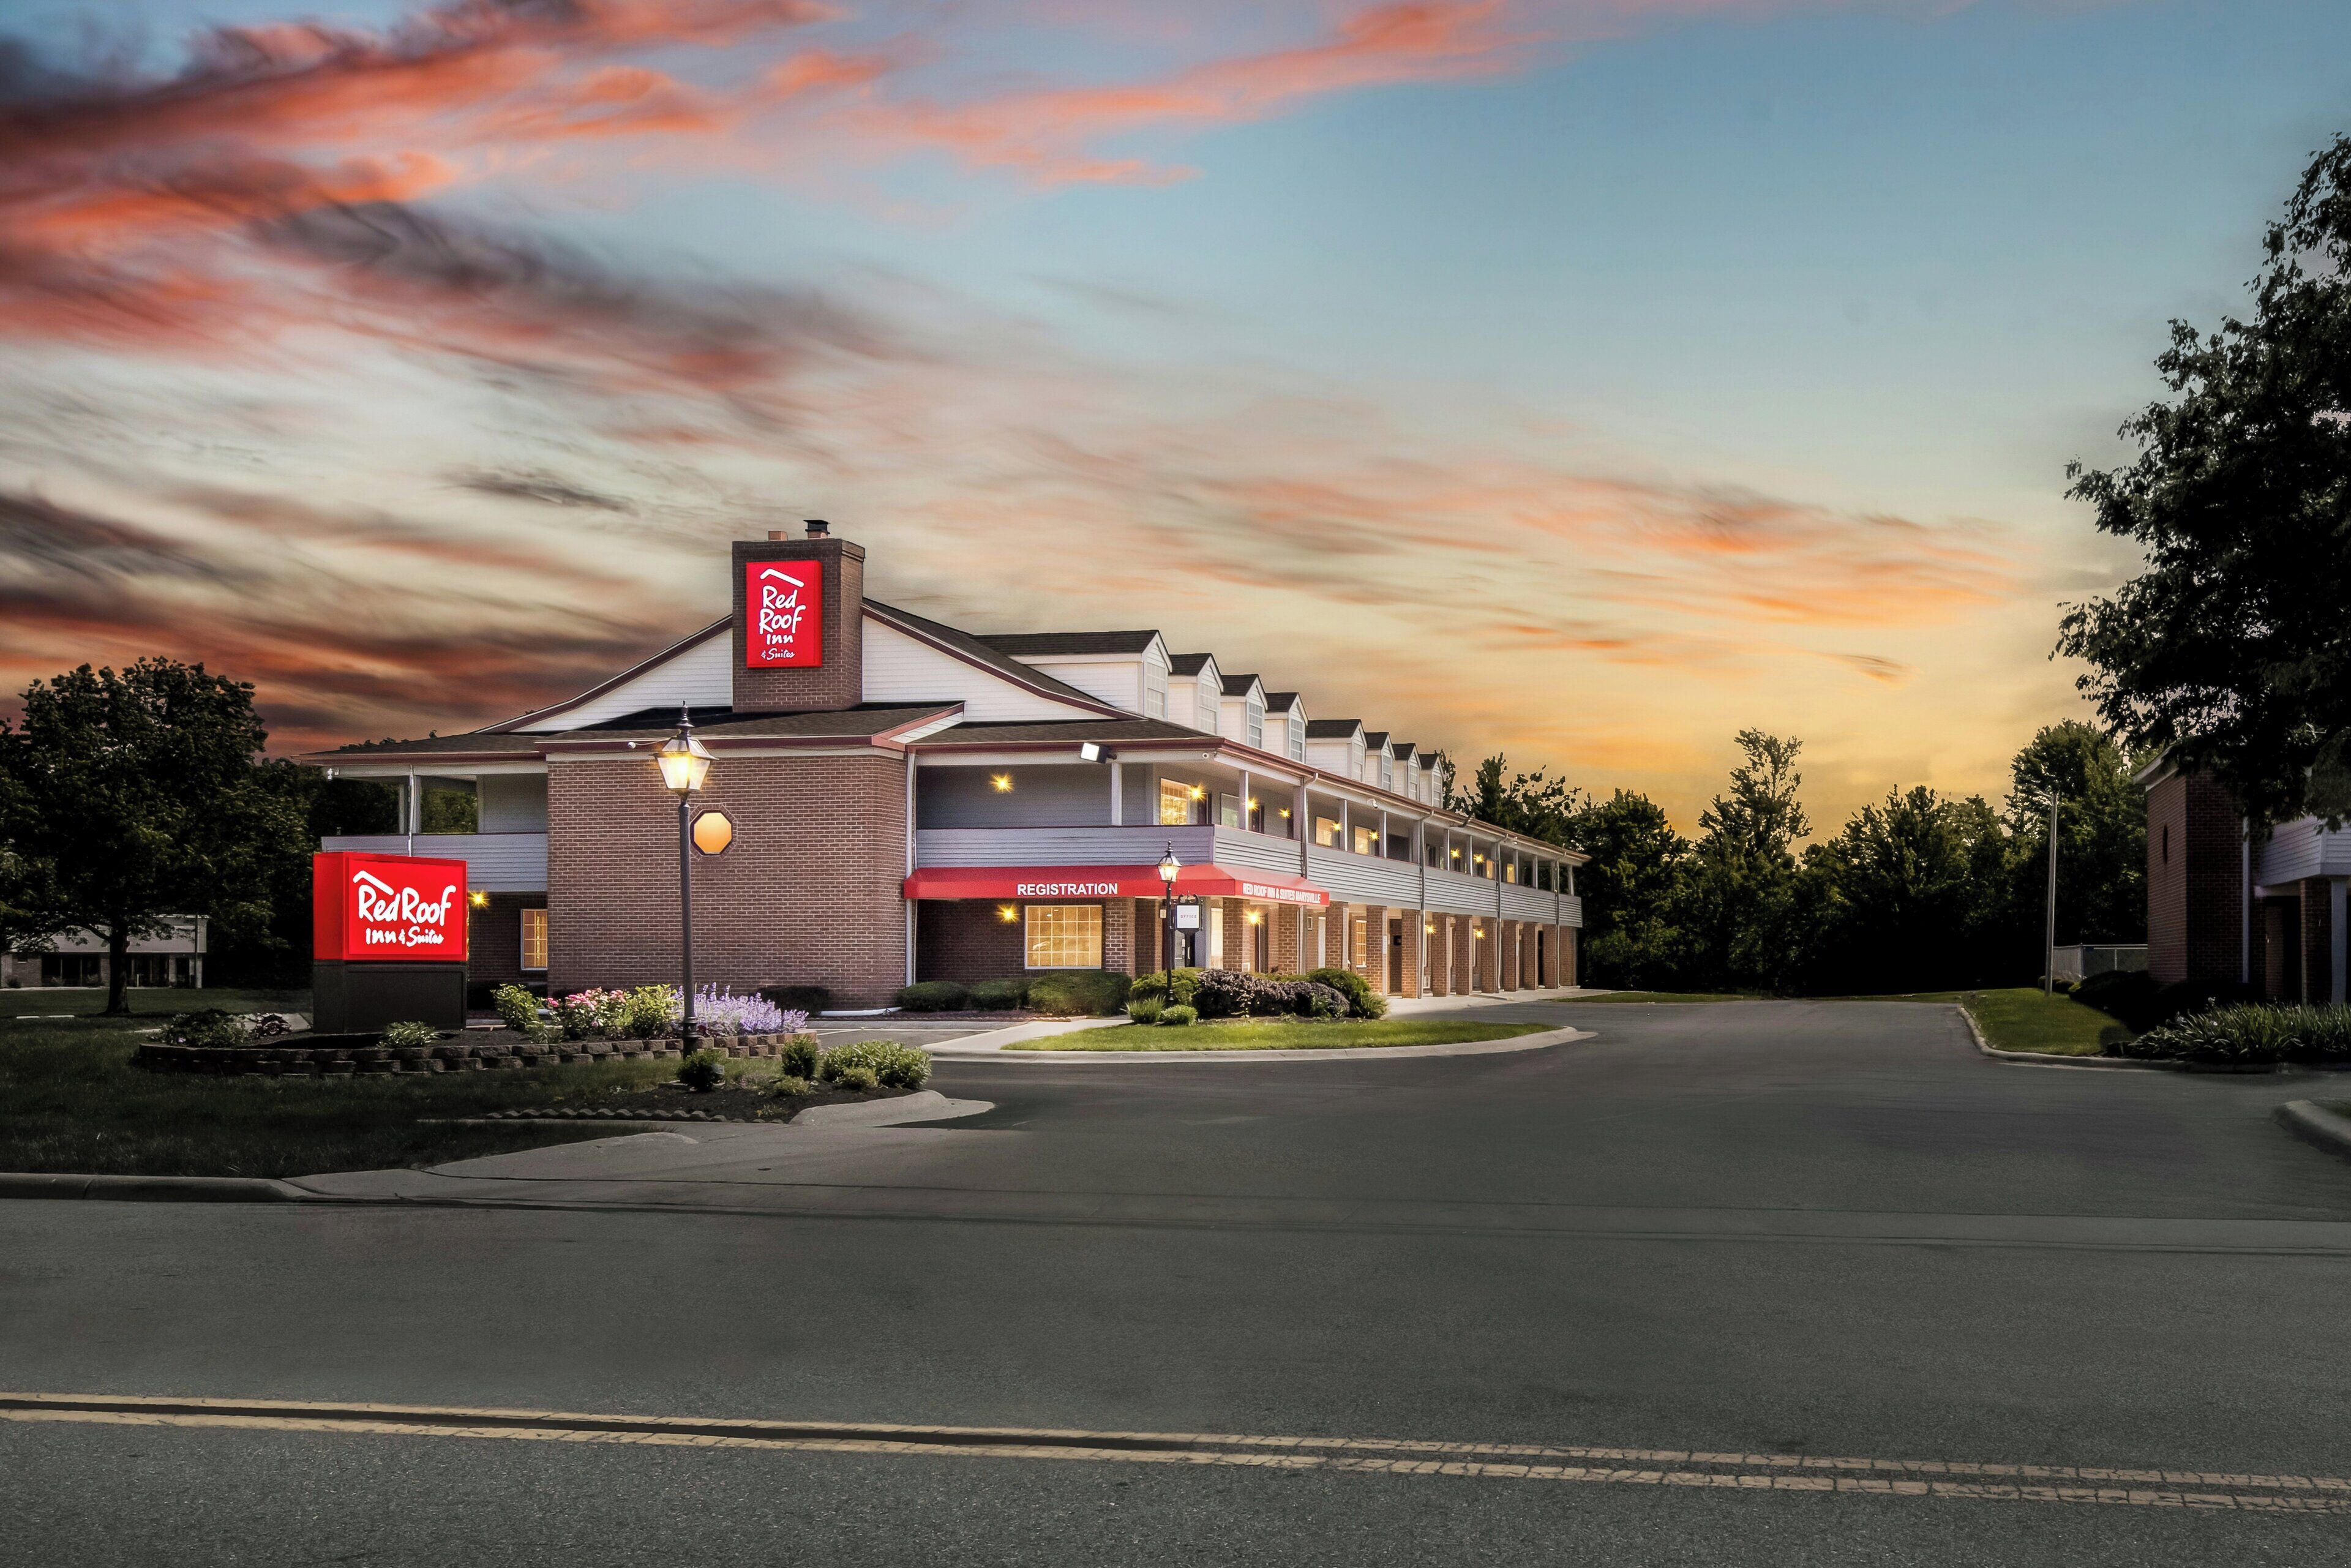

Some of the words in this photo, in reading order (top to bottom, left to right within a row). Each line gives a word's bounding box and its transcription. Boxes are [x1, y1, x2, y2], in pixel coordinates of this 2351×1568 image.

[763, 585, 798, 609] Red
[759, 605, 806, 634] Roof
[767, 634, 793, 645] Inn
[767, 648, 795, 661] Suites
[1017, 883, 1118, 896] REGISTRATION
[1243, 882, 1253, 895] RED
[1253, 884, 1267, 897] ROOF
[1275, 888, 1280, 899] &
[1280, 888, 1295, 901] SUITES
[358, 884, 400, 923] Red
[402, 885, 457, 927] Roof
[366, 928, 397, 945] Inn
[407, 926, 444, 947] Suites
